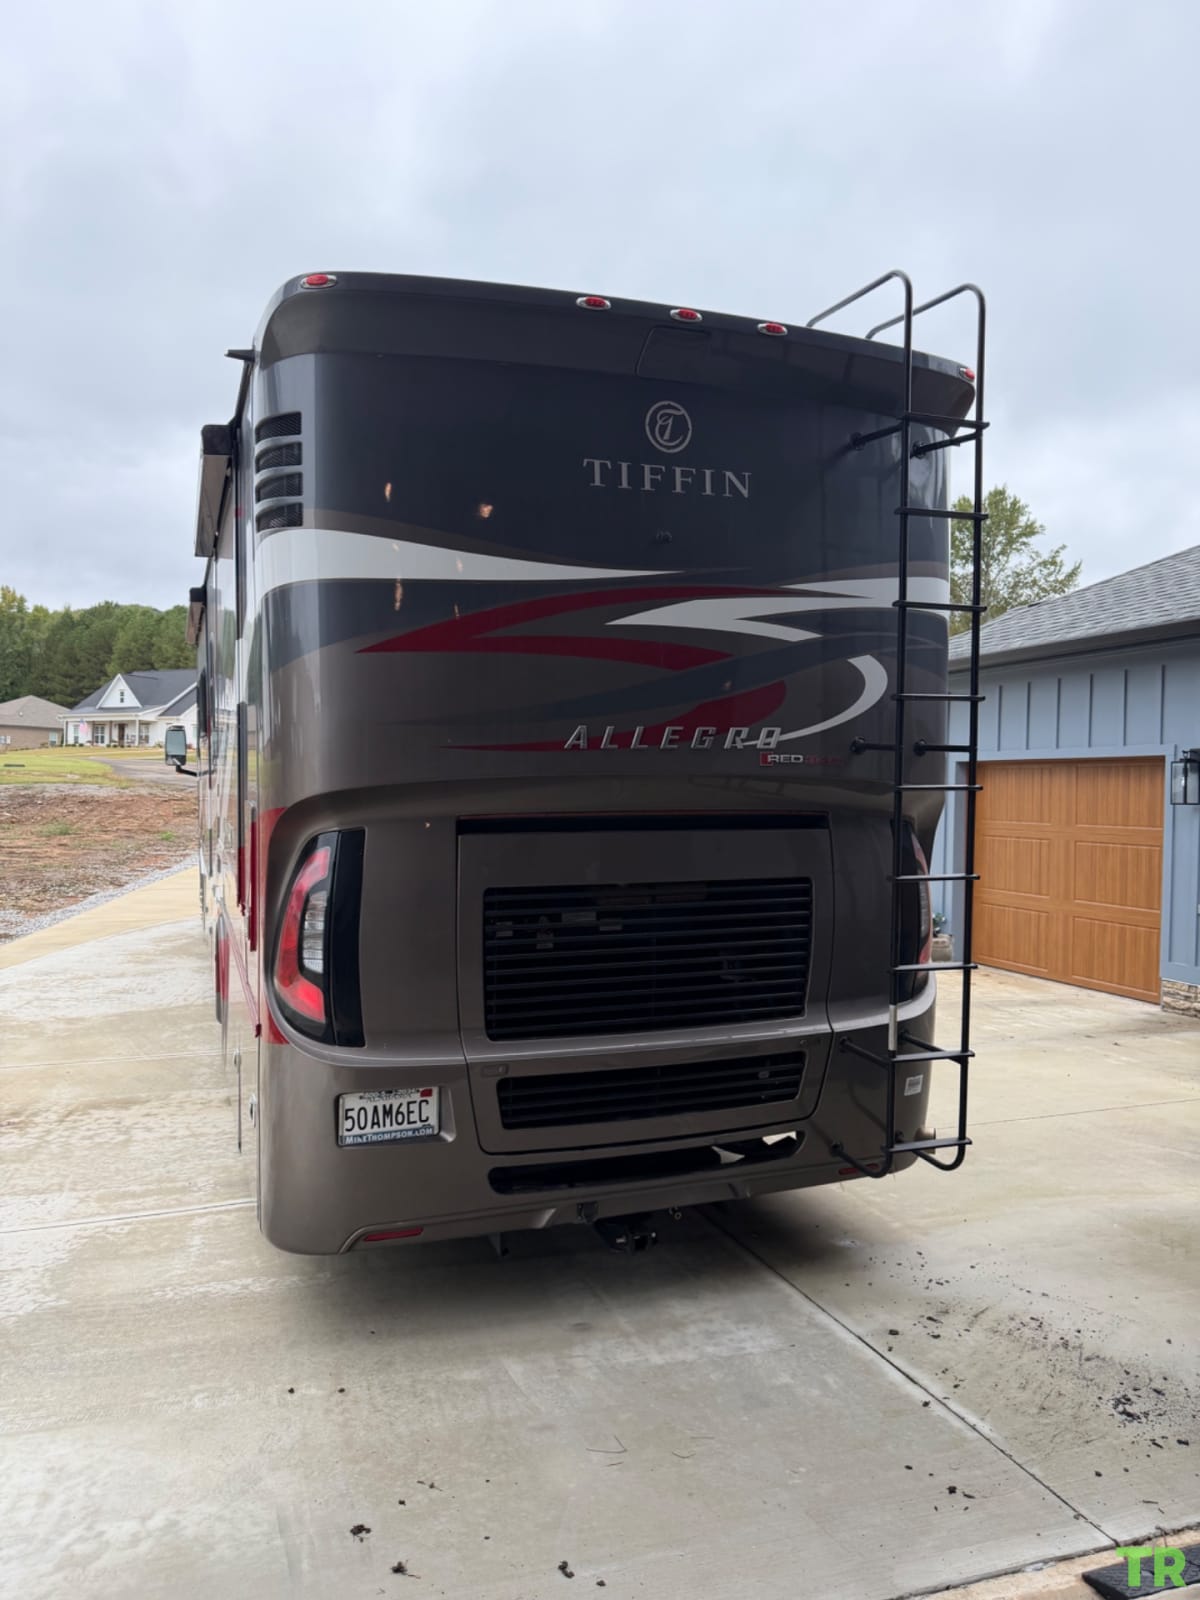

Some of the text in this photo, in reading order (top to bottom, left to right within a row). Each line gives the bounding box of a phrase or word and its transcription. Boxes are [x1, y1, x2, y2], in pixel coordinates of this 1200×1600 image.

[582, 458, 753, 499] TIFFIN
[563, 724, 783, 750] ALLEGRO
[767, 753, 805, 764] RED
[344, 1099, 430, 1132] 50AM6EC
